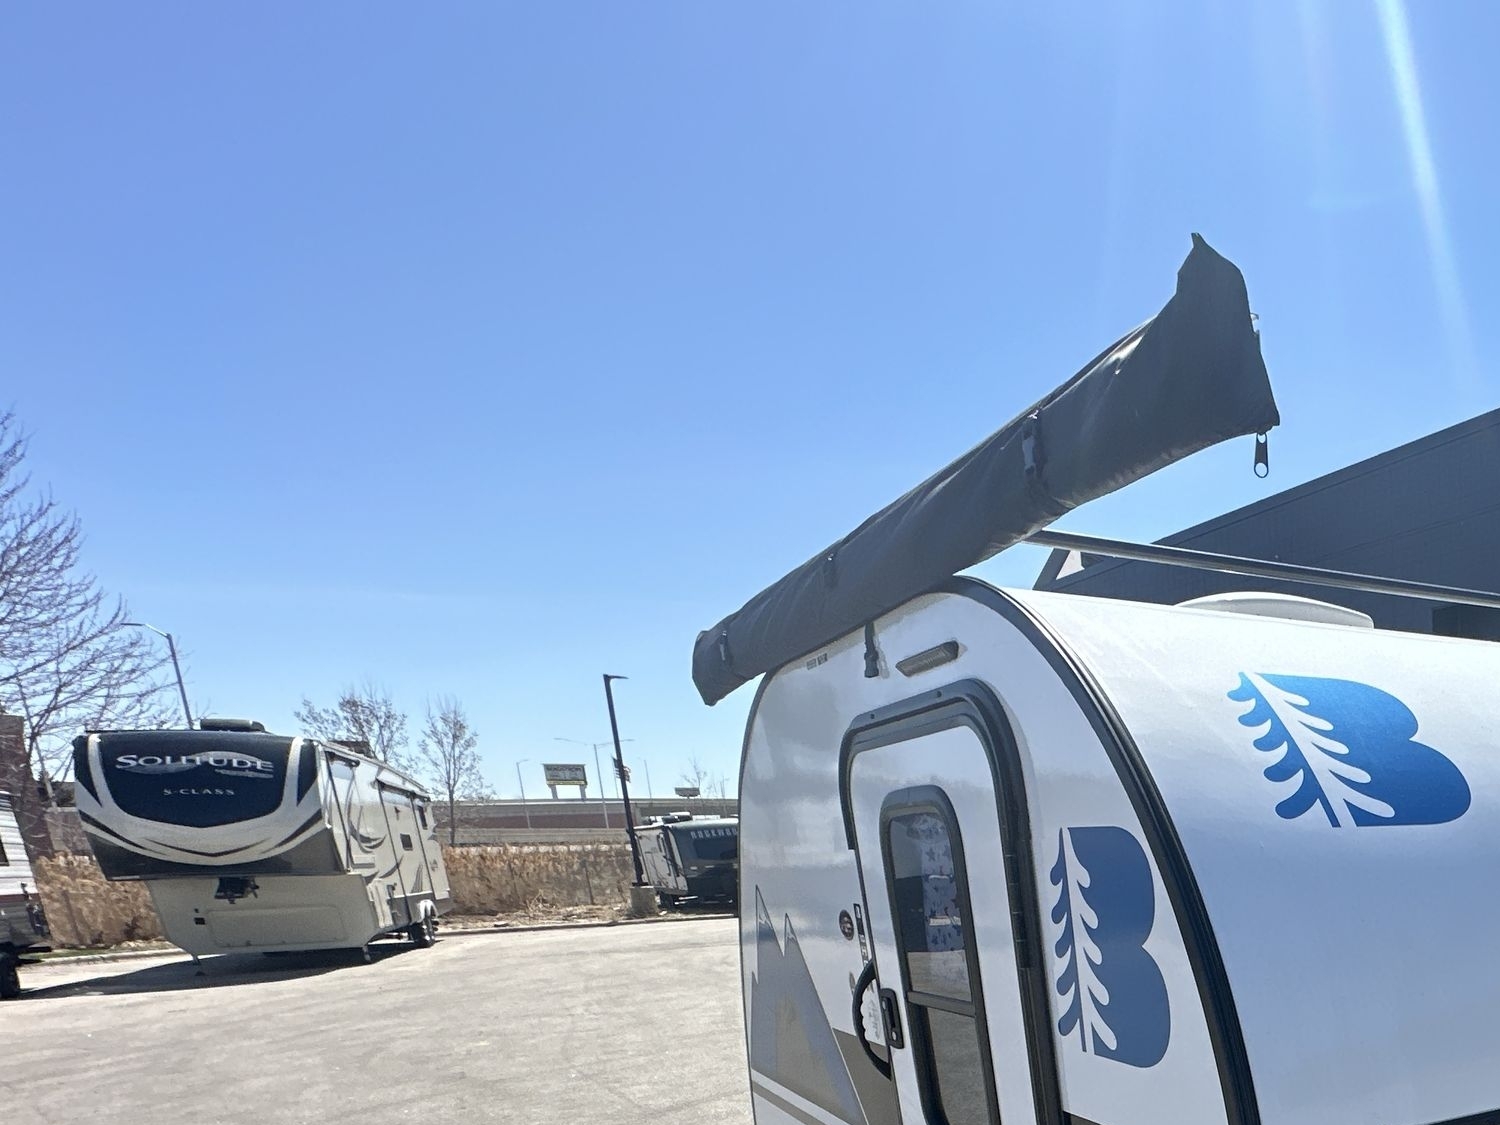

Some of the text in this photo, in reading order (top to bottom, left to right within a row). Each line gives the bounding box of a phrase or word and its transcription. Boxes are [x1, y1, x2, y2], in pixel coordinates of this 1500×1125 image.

[115, 754, 275, 772] SOLITUDE
[163, 788, 236, 796] S-CLASS
[690, 827, 738, 840] ROCKWOO
